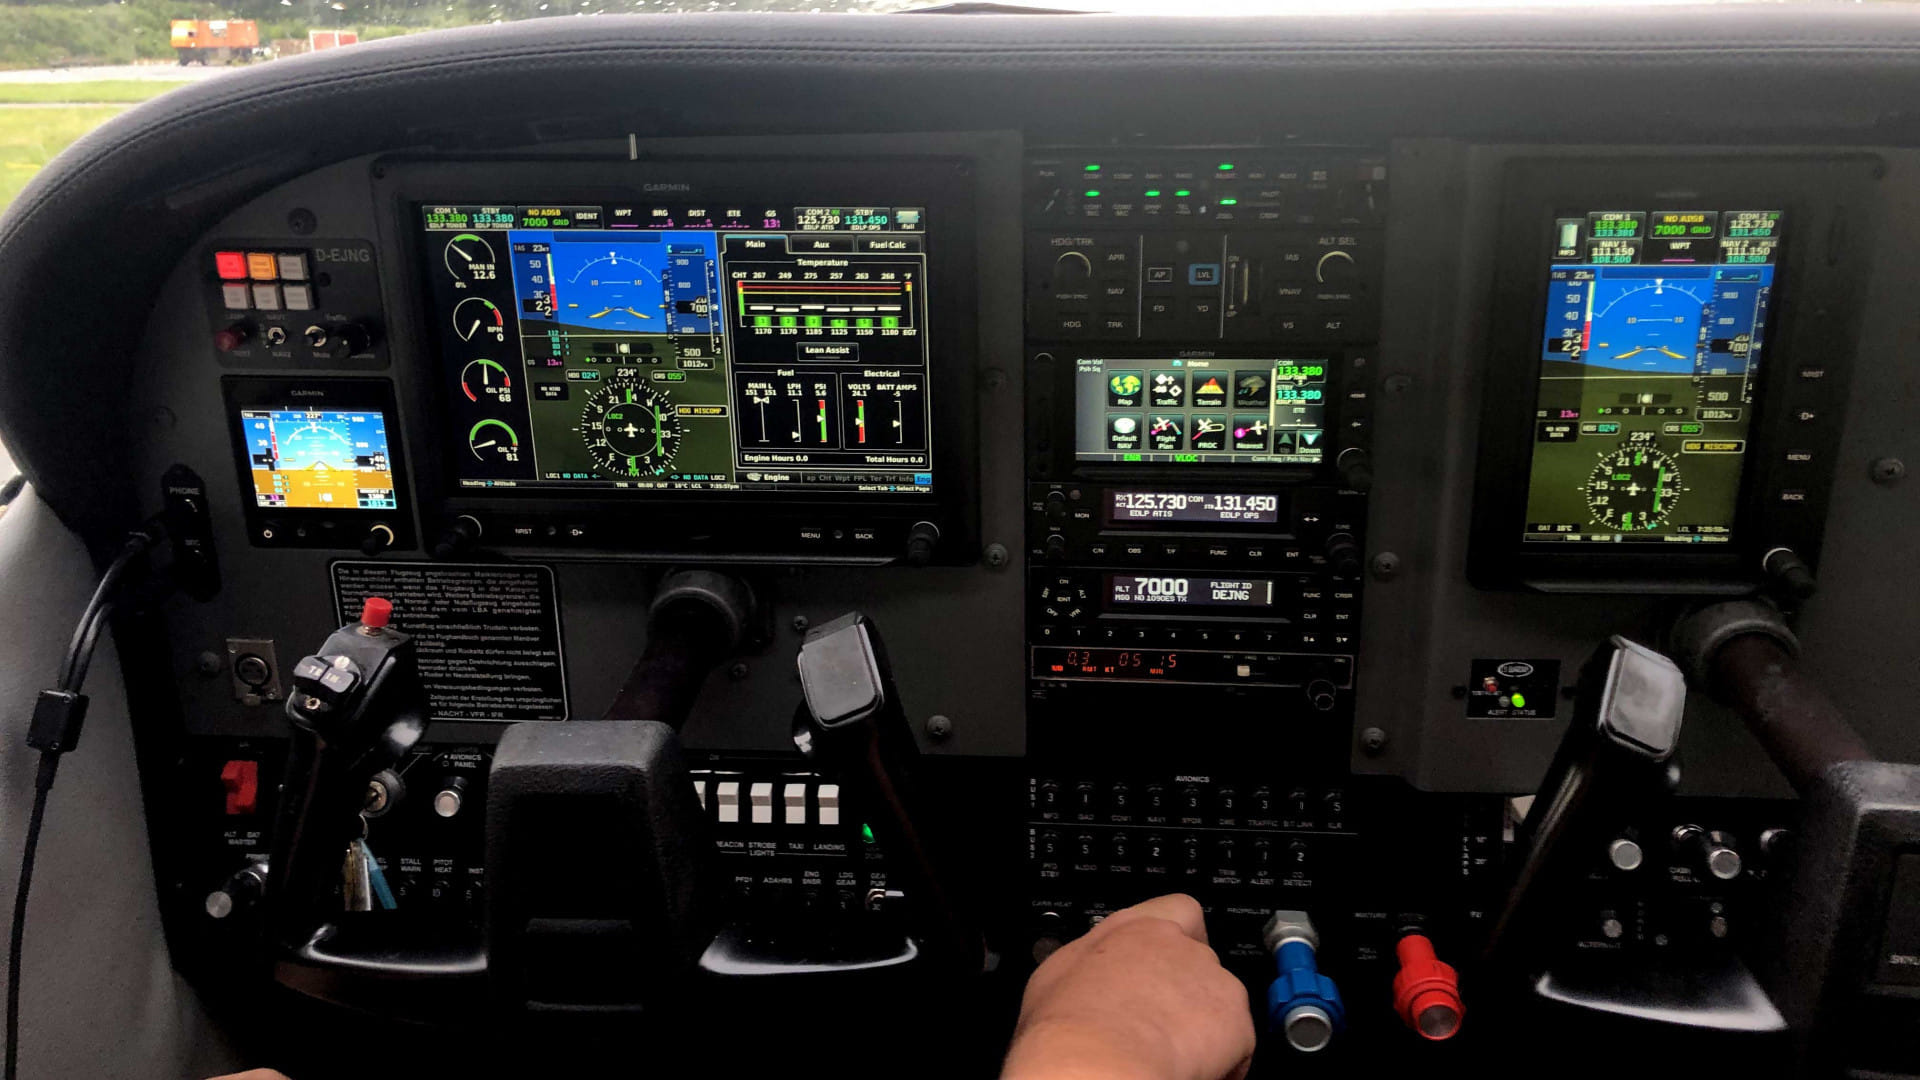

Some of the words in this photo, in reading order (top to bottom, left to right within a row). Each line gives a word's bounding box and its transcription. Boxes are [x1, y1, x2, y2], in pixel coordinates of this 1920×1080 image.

[615, 209, 632, 217] WPT
[652, 209, 668, 217] BRG
[426, 214, 468, 222] 133.380
[472, 214, 514, 222] 133.380
[797, 216, 840, 224] 125.730
[844, 216, 888, 225] 131.450
[522, 218, 548, 227] 7000
[1594, 220, 1638, 230] 133.380
[1730, 220, 1774, 228] 125.730
[1654, 226, 1686, 235] 7000
[746, 240, 766, 248] Main
[813, 241, 830, 249] Aux
[870, 241, 888, 249] Fuel
[889, 241, 906, 249] Calc
[1318, 237, 1334, 246] ALT
[1337, 237, 1358, 246] SEL
[1669, 242, 1692, 250] WPT
[315, 248, 370, 262] D-EJNG
[1591, 248, 1635, 256] 111.150
[1726, 247, 1770, 256] 111.150
[1108, 254, 1126, 262] APR
[1284, 254, 1300, 262] IAS
[530, 260, 542, 268] 50
[797, 258, 848, 268] Temperature
[473, 270, 496, 280] 12.6
[1196, 270, 1212, 279] LVL
[531, 276, 543, 284] 40
[1107, 288, 1124, 296] NAV
[1280, 288, 1302, 296] VNAV
[1153, 304, 1165, 312] FD
[1196, 304, 1209, 312] YD
[1063, 320, 1082, 329] HDG
[1106, 320, 1124, 329] TRK
[1283, 320, 1294, 329] VS
[1326, 320, 1342, 329] ALT
[497, 333, 504, 342] 0
[684, 348, 701, 357] 500
[805, 346, 822, 354] Lean
[824, 346, 850, 354] Assist
[1188, 360, 1209, 368] Home
[617, 368, 637, 377] 234°
[1278, 366, 1323, 376] 133.380
[499, 394, 512, 402] 68
[1277, 390, 1322, 400] 133.380
[1708, 391, 1728, 402] 500
[1117, 398, 1133, 406] Map
[592, 422, 602, 430] 15
[1156, 435, 1177, 443] Flight
[1630, 432, 1654, 441] 234°
[1300, 447, 1320, 455] Down
[506, 453, 518, 462] 81
[744, 454, 770, 463] Engine
[772, 454, 794, 462] Hours
[886, 456, 908, 464] Hours
[764, 474, 790, 482] Engine
[1126, 494, 1186, 510] 125.730
[1214, 495, 1276, 512] 131.450
[800, 532, 820, 540] MENU
[855, 532, 874, 540] BACK
[1115, 585, 1130, 593] ALT
[1135, 578, 1189, 595] 7000
[1212, 590, 1250, 600] DEJNG
